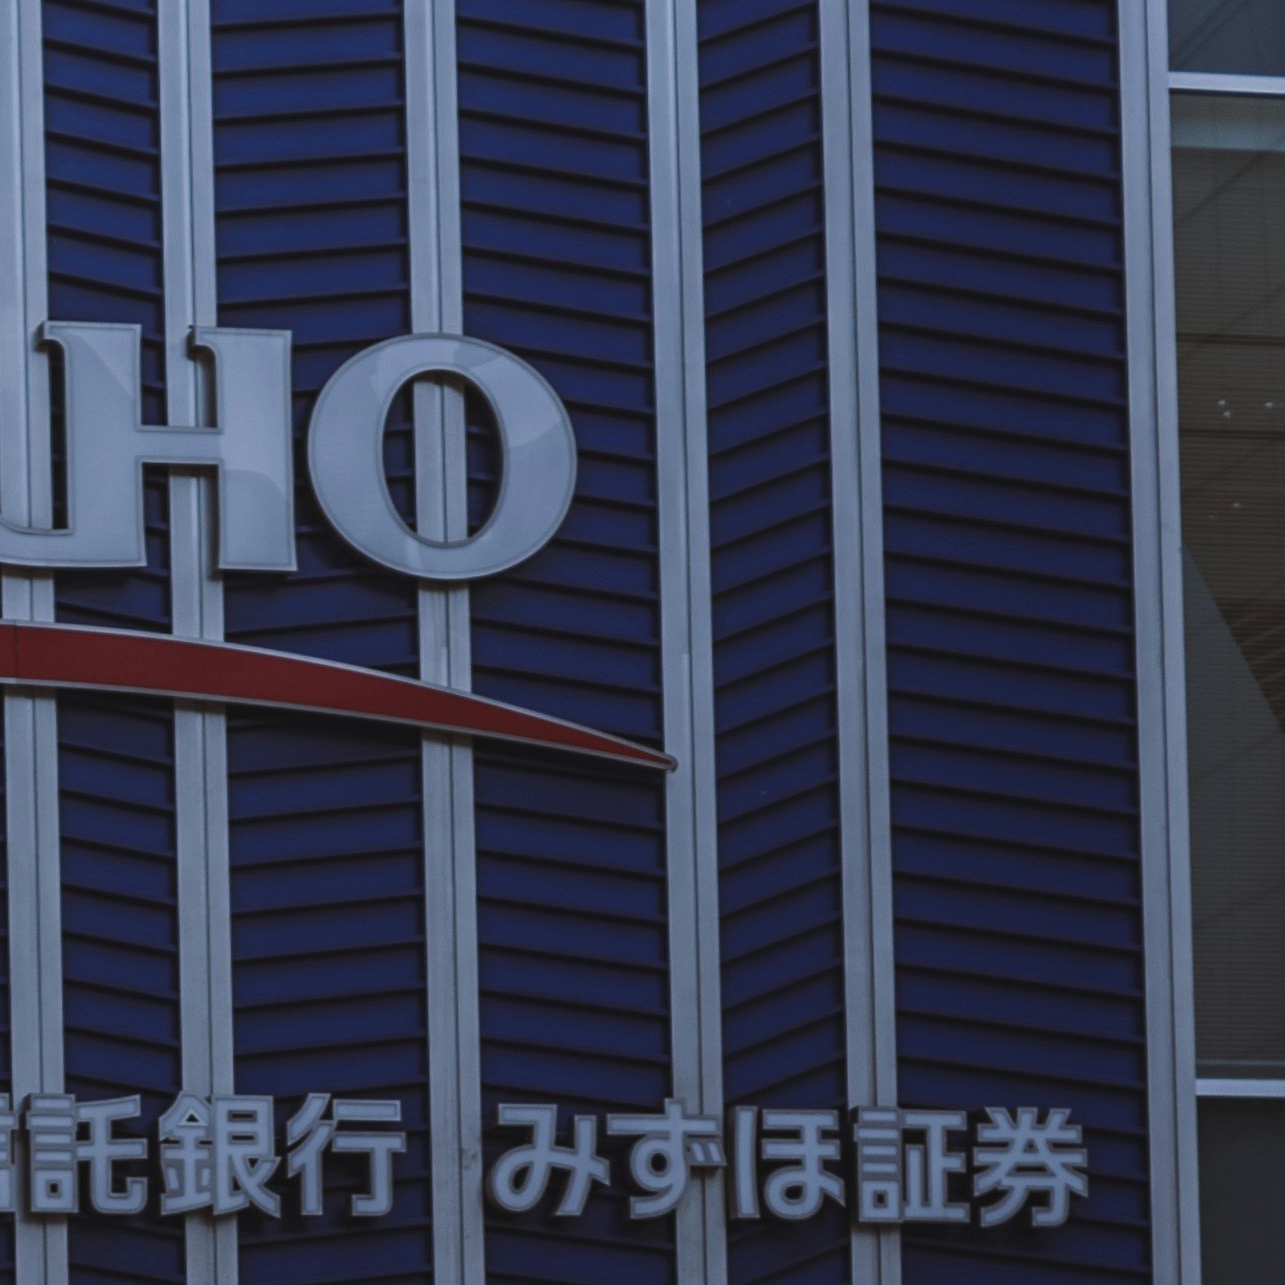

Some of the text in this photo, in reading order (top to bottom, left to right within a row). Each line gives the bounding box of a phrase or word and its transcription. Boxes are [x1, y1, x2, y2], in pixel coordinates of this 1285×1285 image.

[490, 1098, 1090, 1228] みずほ証券
